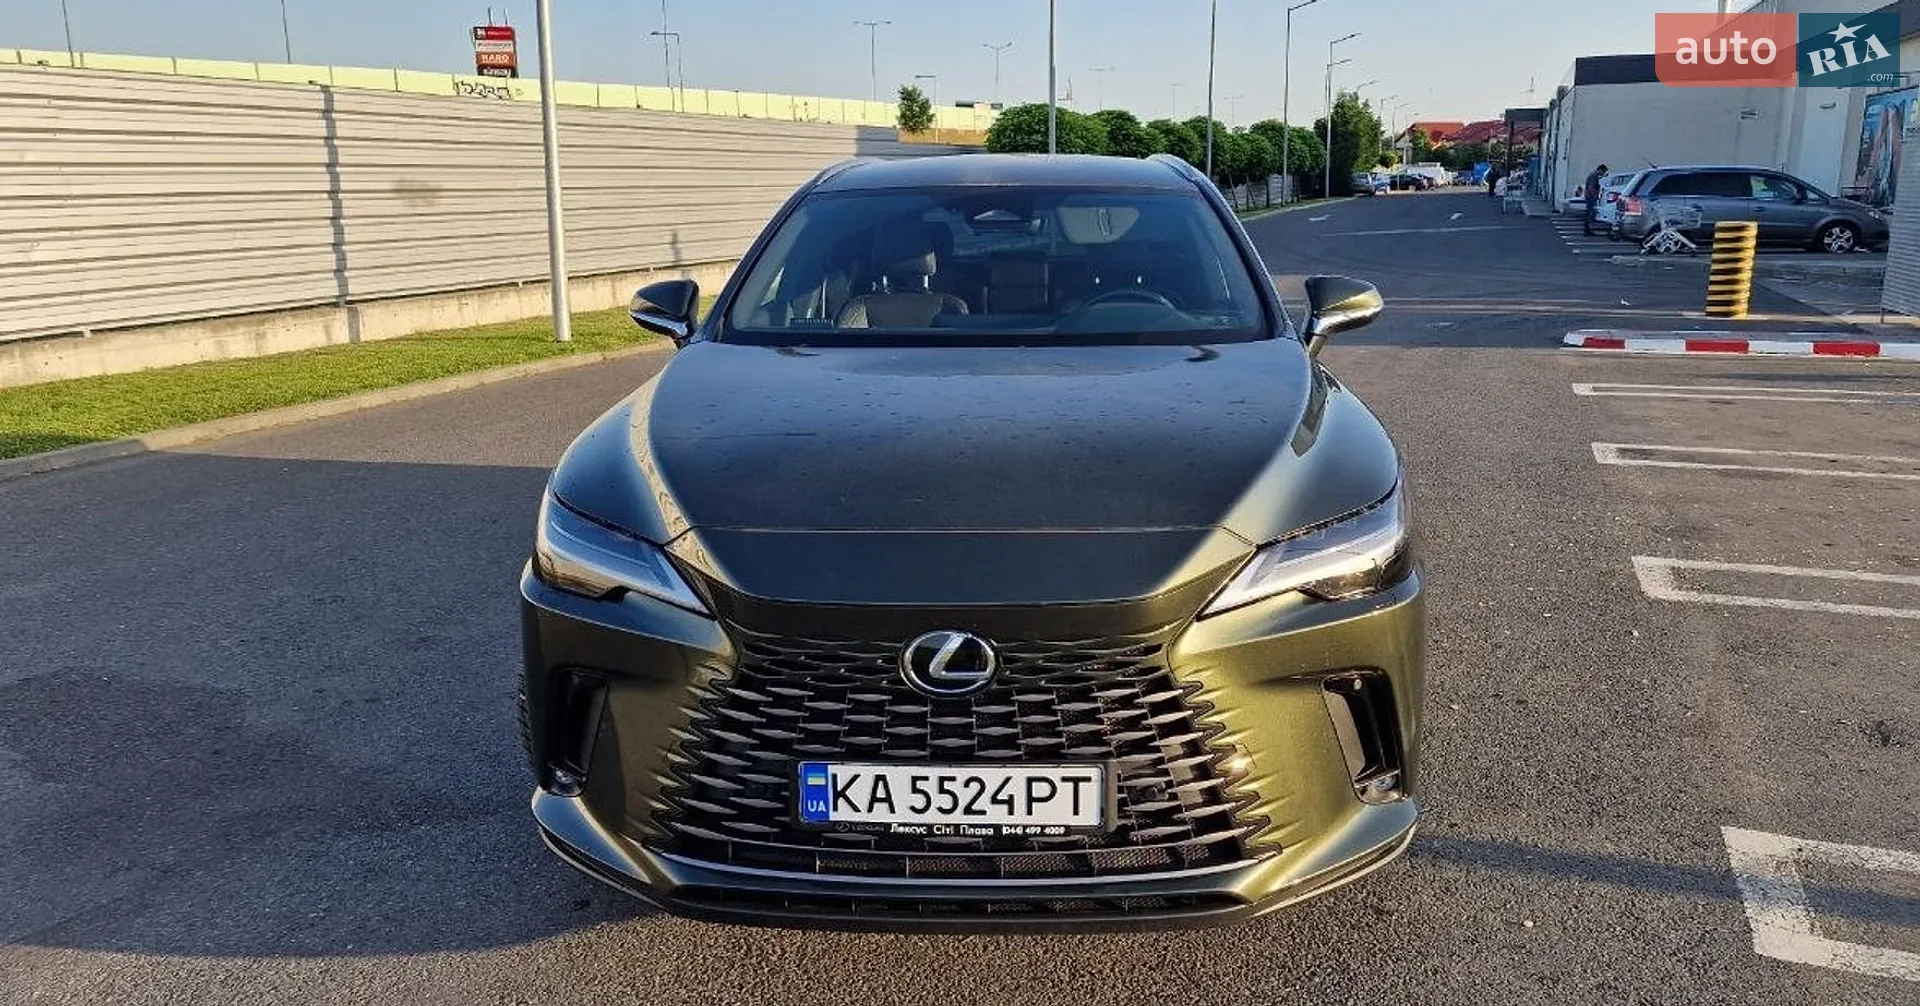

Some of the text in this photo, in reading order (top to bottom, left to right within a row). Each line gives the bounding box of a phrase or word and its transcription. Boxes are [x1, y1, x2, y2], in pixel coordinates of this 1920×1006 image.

[807, 801, 827, 813] UA
[830, 772, 1093, 817] KA 5524 PT
